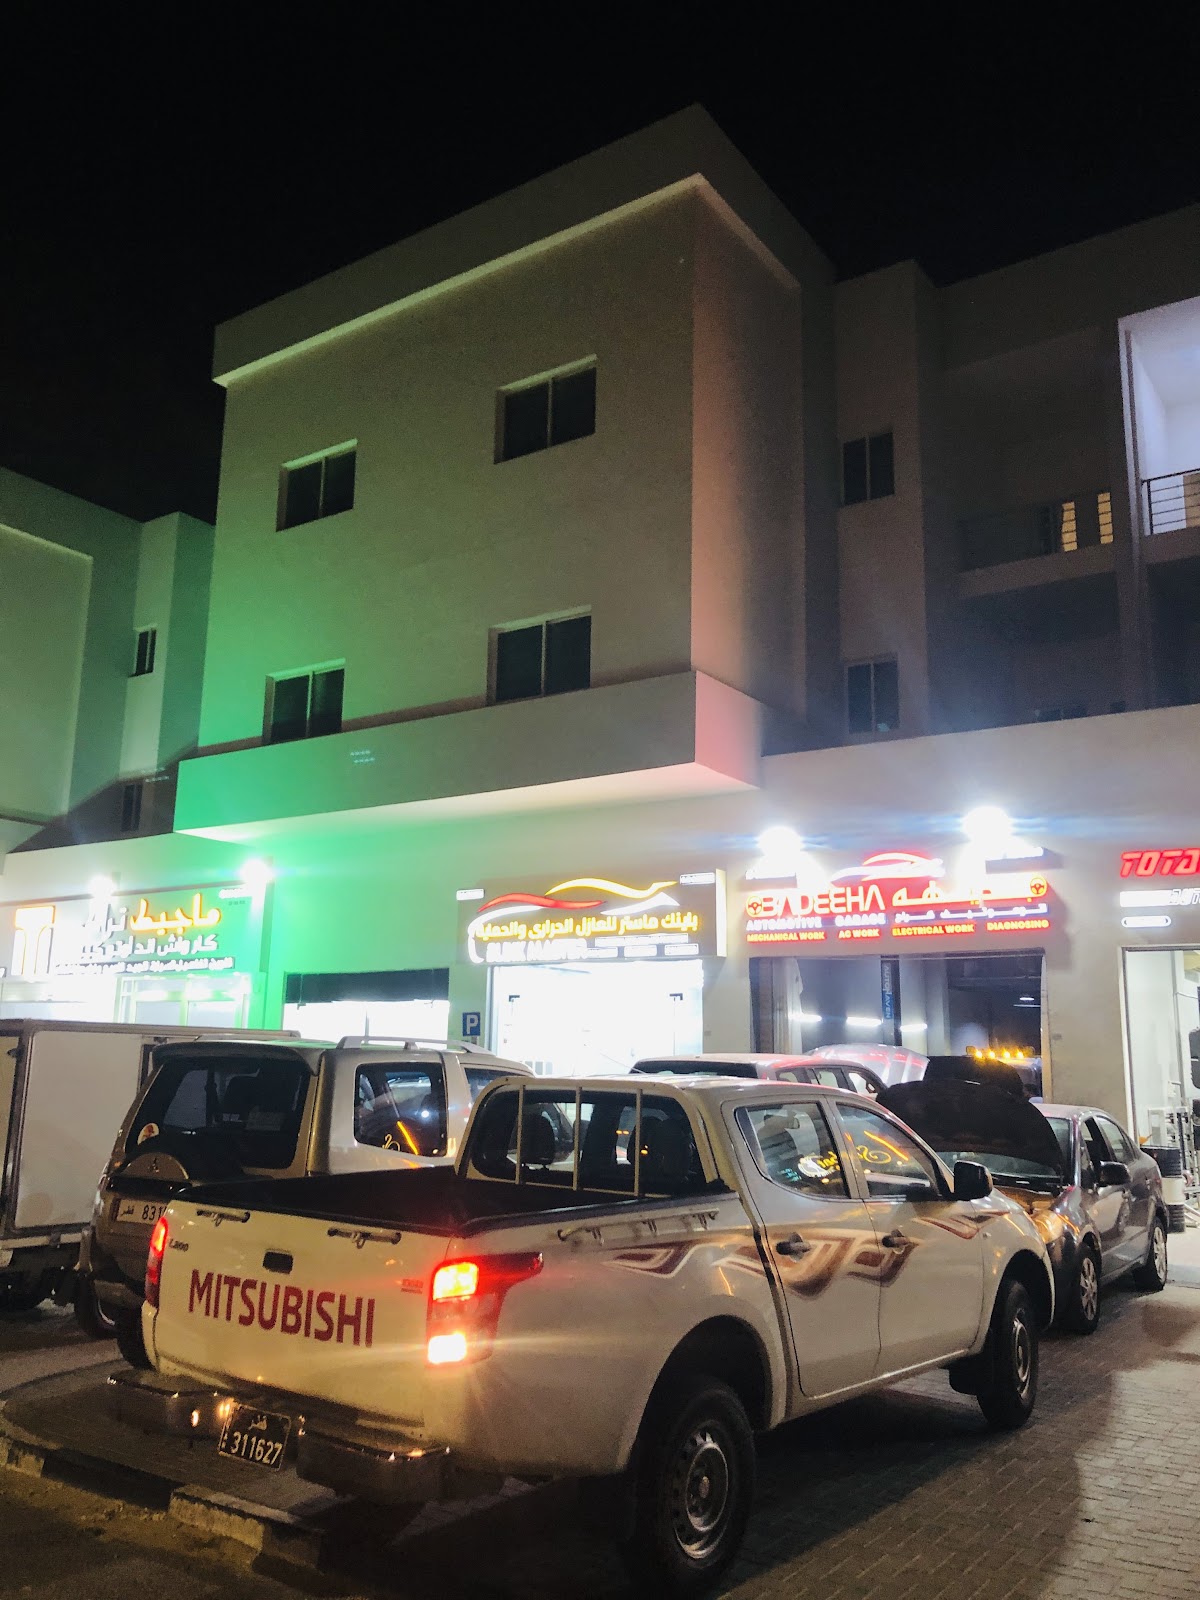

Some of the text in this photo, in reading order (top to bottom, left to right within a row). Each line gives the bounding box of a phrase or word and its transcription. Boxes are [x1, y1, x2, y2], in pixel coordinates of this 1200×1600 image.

[761, 884, 886, 917] BADEEHA
[892, 923, 975, 936] ELECTRICAL WORK
[986, 919, 1050, 931] DIAGNOSING
[746, 931, 825, 943] MECHANICAL WORK
[838, 928, 880, 939] AC WORK
[466, 1015, 479, 1034] P
[188, 1269, 375, 1349] MITSUBISHI
[230, 1431, 283, 1465] 311627
